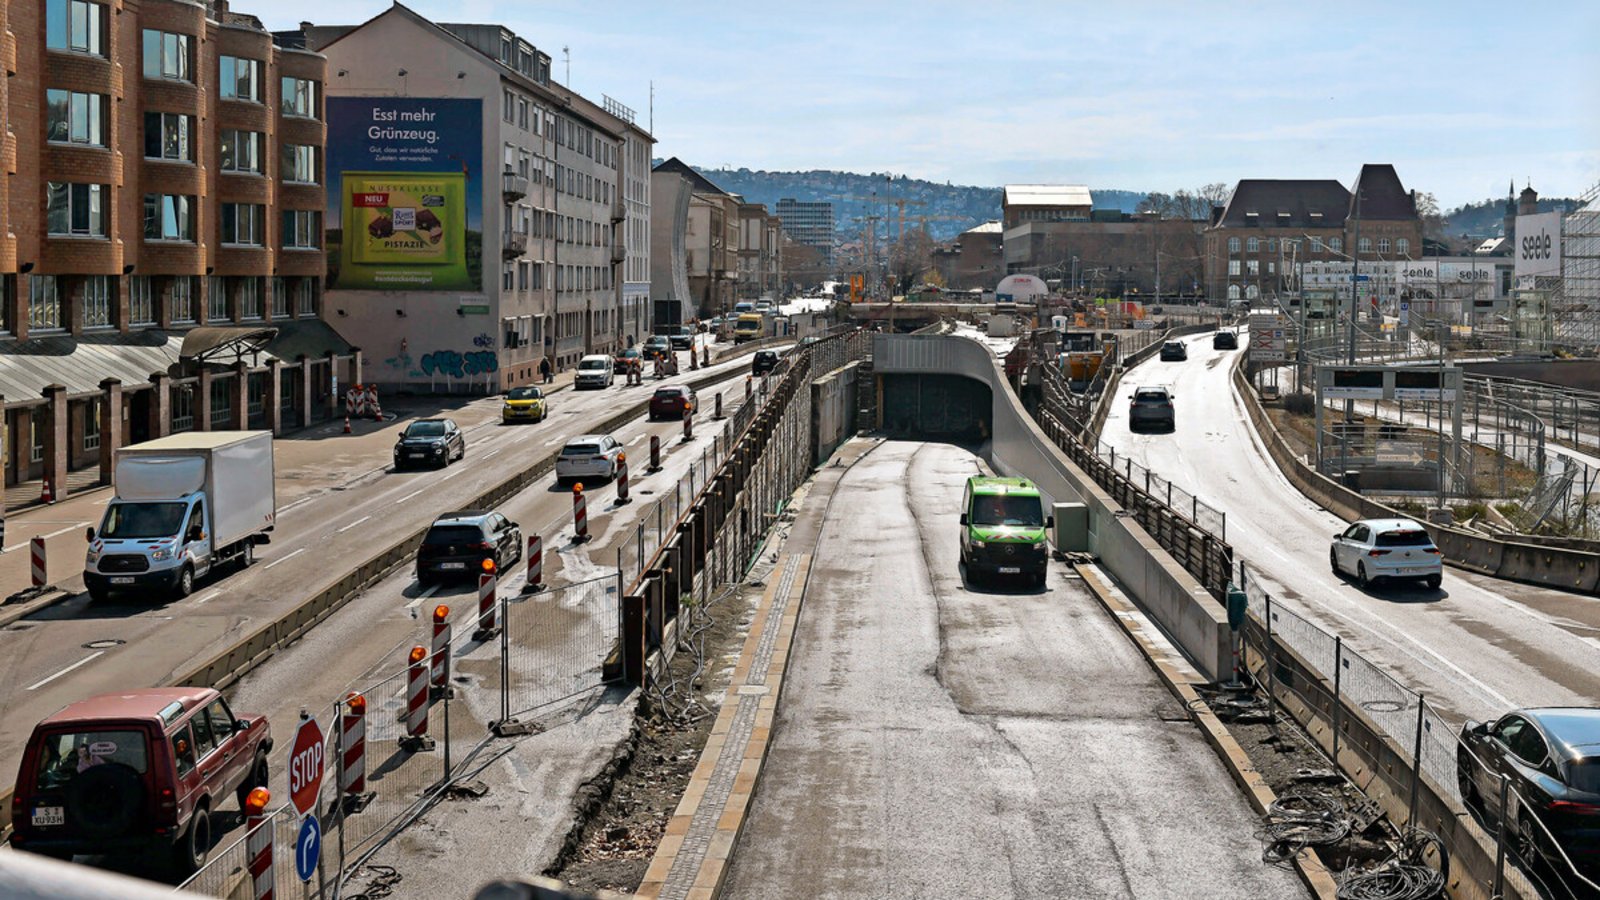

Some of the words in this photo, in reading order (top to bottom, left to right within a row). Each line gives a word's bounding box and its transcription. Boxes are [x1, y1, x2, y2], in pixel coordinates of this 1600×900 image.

[372, 108, 397, 121] Esst
[400, 108, 436, 121] mehr
[368, 126, 440, 144] Grünzeug.
[364, 195, 383, 203] NEU
[384, 241, 424, 249] PISTAZIE
[1522, 228, 1552, 260] seele
[1402, 267, 1433, 278] seele
[1459, 268, 1489, 280] seele
[291, 741, 322, 793] STOP
